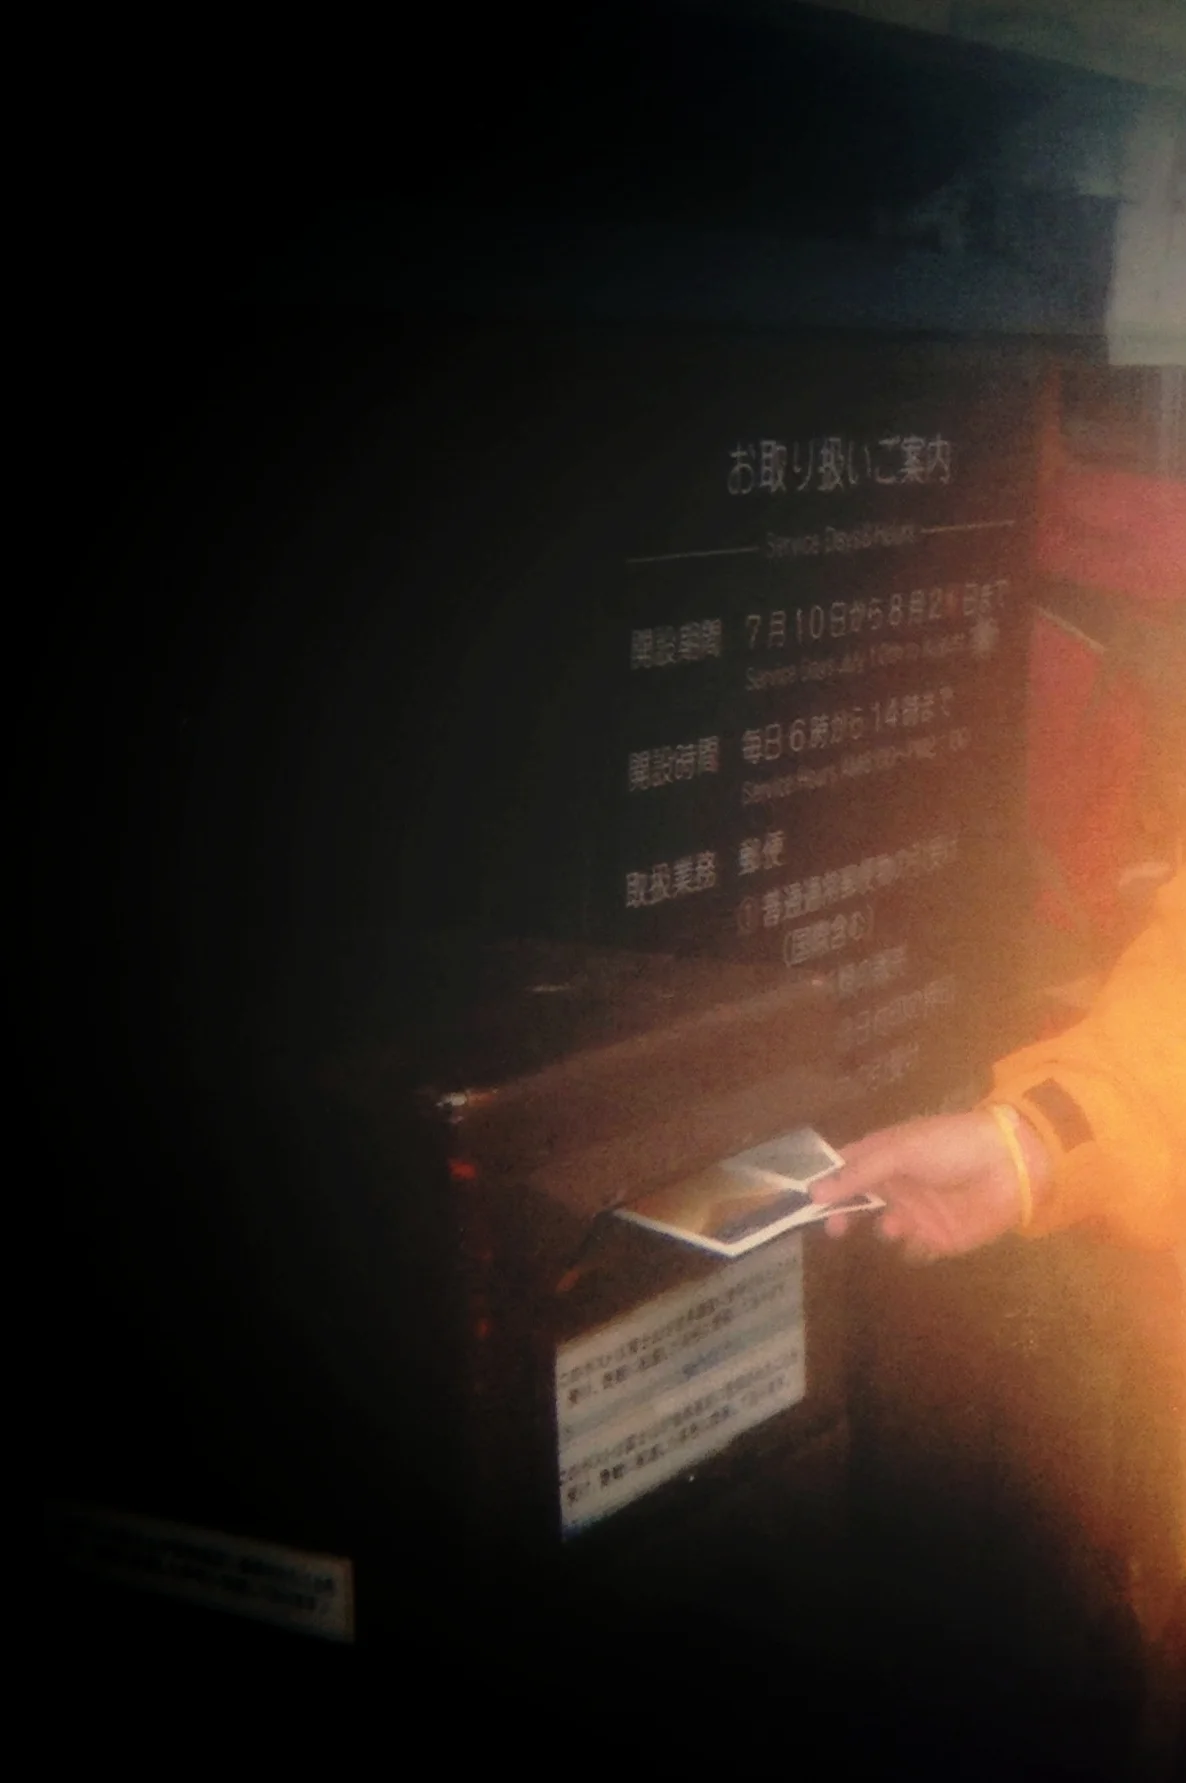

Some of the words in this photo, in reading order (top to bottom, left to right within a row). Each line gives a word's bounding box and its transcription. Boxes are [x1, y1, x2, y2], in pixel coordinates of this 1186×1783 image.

[727, 433, 952, 496] お取り扱いご案内
